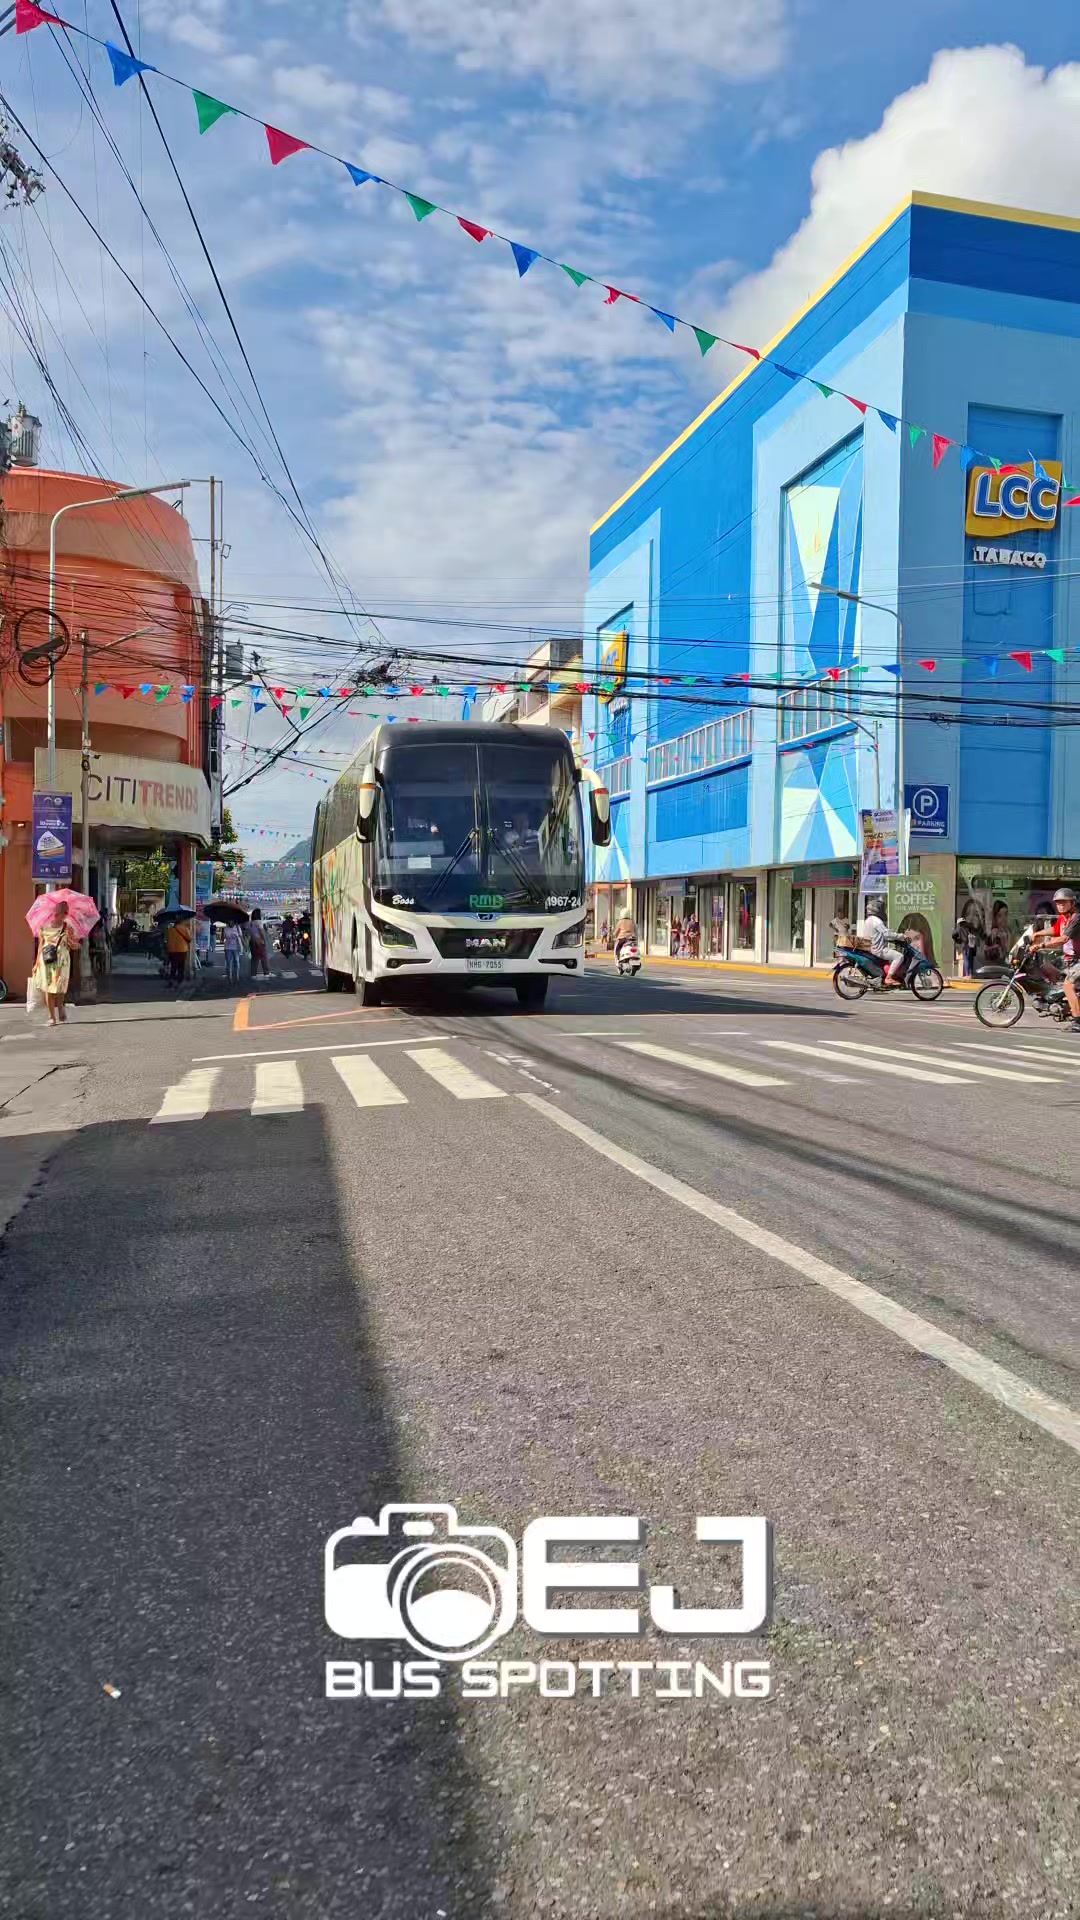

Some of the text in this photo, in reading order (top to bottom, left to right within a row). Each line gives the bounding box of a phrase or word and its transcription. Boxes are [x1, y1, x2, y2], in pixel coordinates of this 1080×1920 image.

[974, 472, 1060, 521] LCC
[973, 546, 1047, 569] TABACO
[895, 880, 934, 892] PICKUP
[895, 894, 936, 905] COFFEE
[465, 938, 506, 948] MAN
